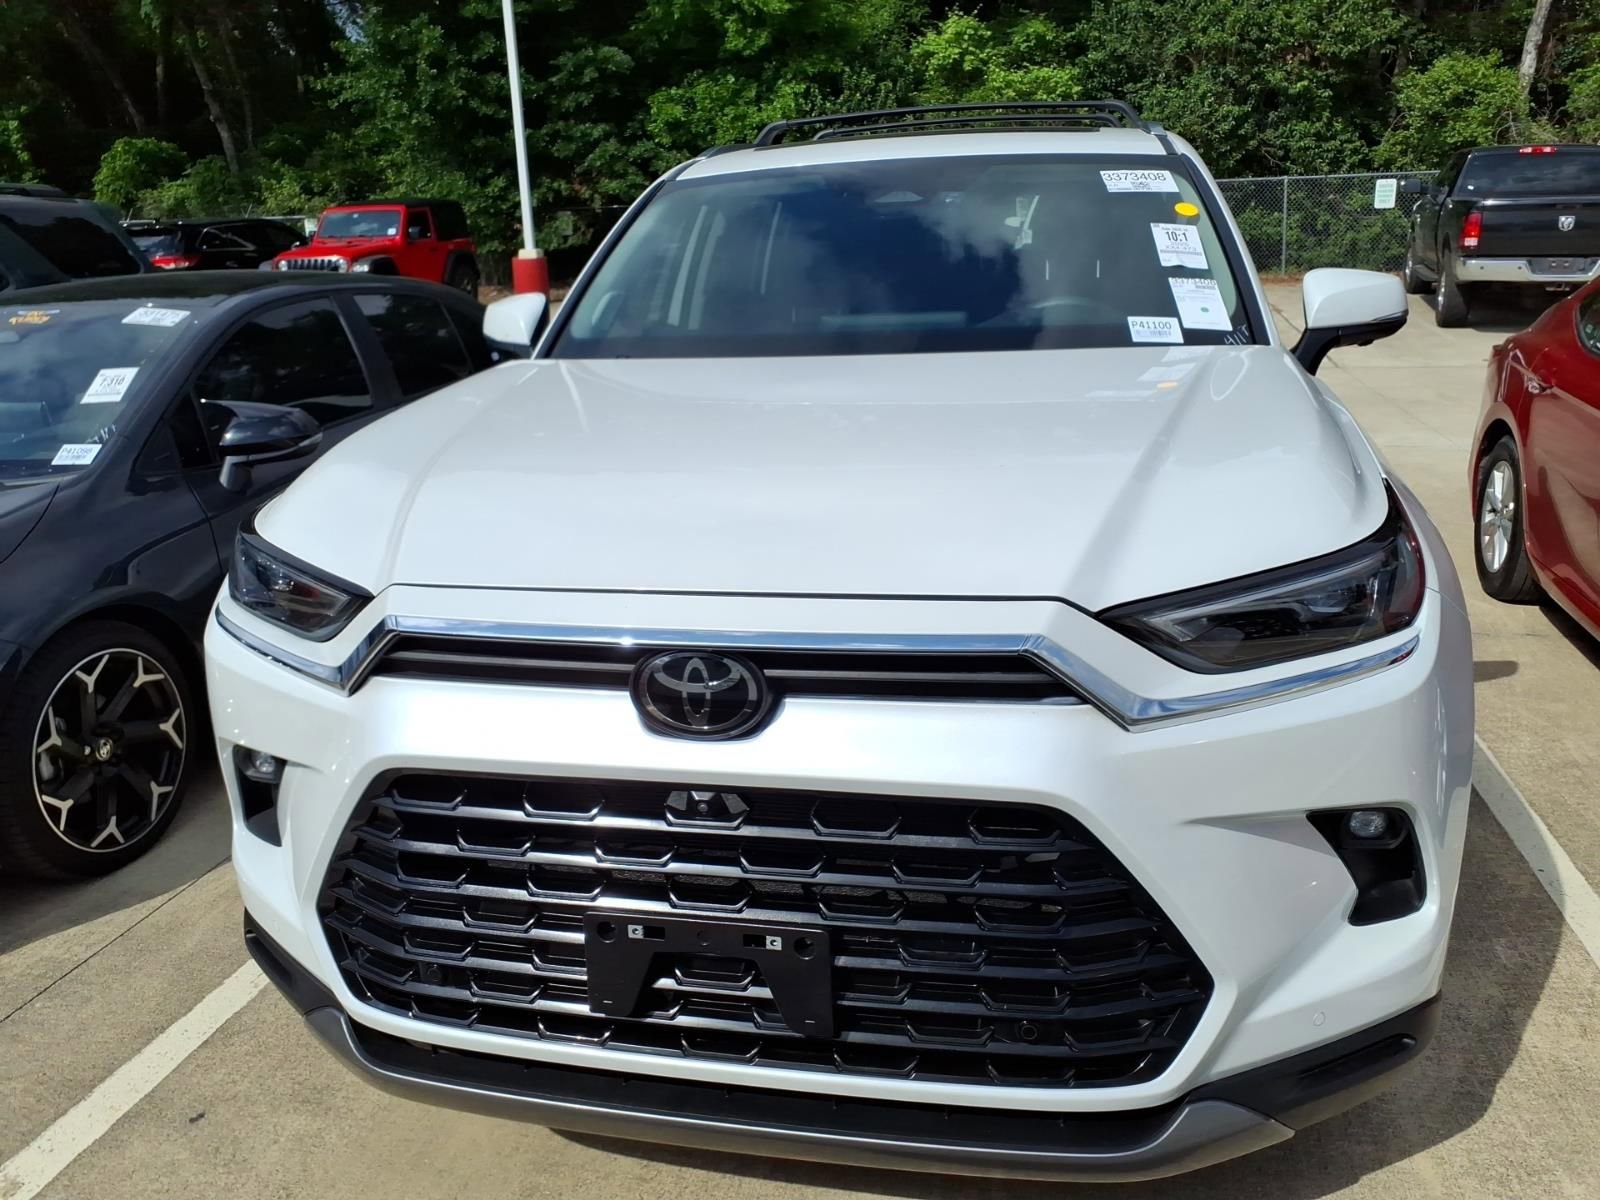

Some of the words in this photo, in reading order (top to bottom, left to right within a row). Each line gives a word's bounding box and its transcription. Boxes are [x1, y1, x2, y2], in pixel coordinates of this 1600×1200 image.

[1103, 172, 1167, 181] 3373408
[1165, 231, 1188, 242] 10:1
[1131, 320, 1172, 330] P41100
